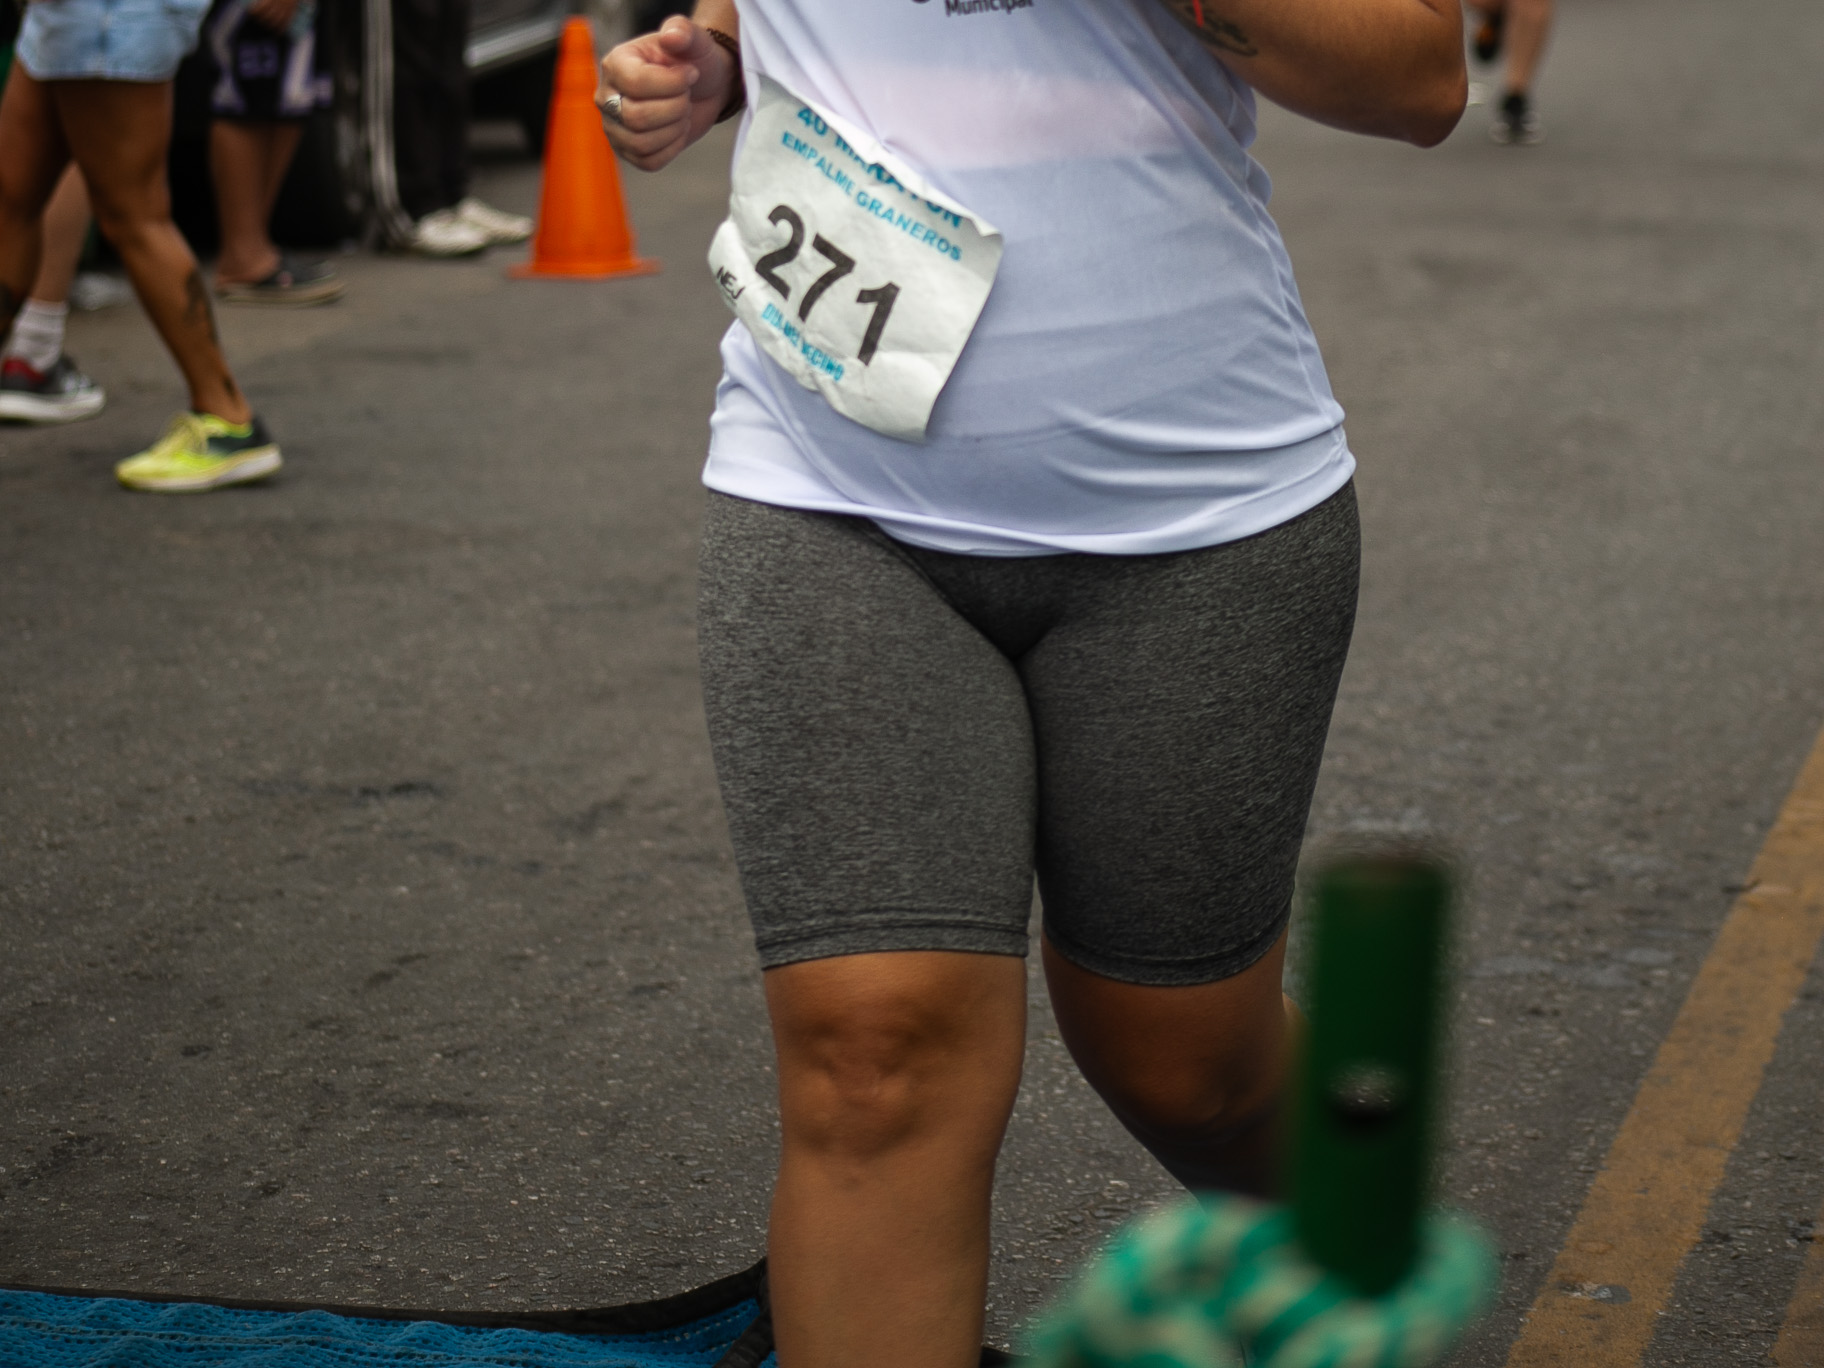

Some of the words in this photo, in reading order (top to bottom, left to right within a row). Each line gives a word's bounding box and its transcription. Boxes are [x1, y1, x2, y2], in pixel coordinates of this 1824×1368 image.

[797, 106, 829, 136] 40
[782, 131, 856, 197] EMPALME
[856, 191, 963, 261] GRANEROS
[754, 205, 901, 367] 271
